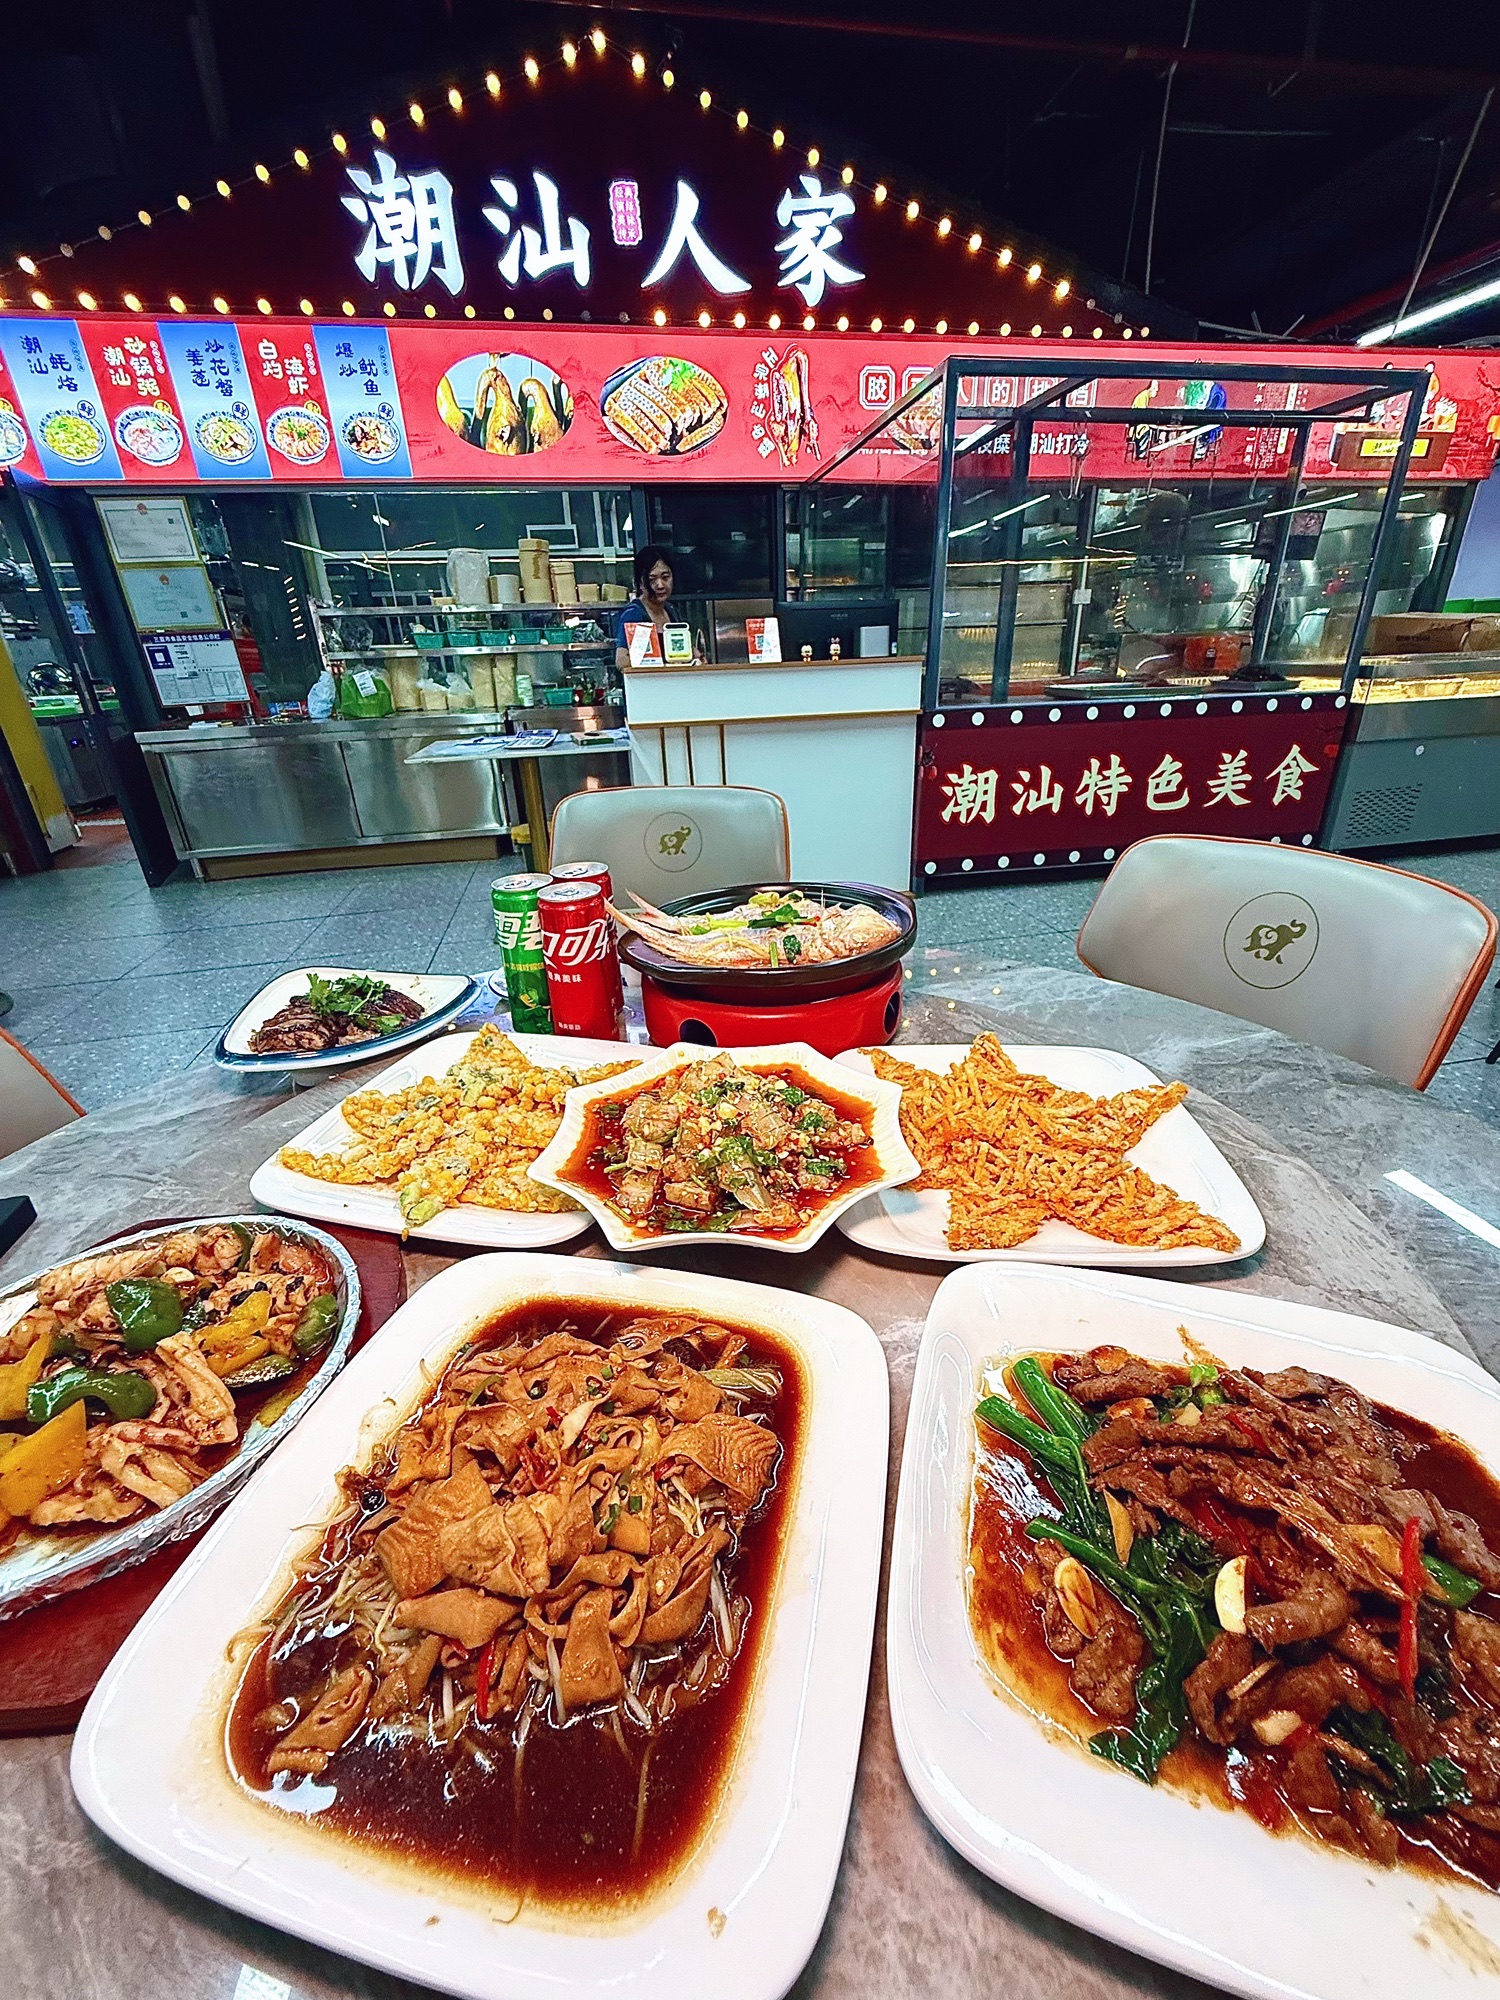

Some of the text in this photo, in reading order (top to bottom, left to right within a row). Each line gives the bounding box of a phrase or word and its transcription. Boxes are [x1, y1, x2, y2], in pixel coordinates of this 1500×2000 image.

[340, 149, 866, 306] 潮汕人家
[19, 334, 49, 375] 潮汕
[102, 345, 131, 387] 潮汕
[185, 348, 210, 387] 姜葱
[205, 338, 234, 397] 炒花蟹
[257, 338, 284, 380] 白灼
[335, 342, 358, 377] 爆炒
[357, 357, 382, 396] 鱿鱼
[940, 744, 1320, 824] 潮汕特色美食
